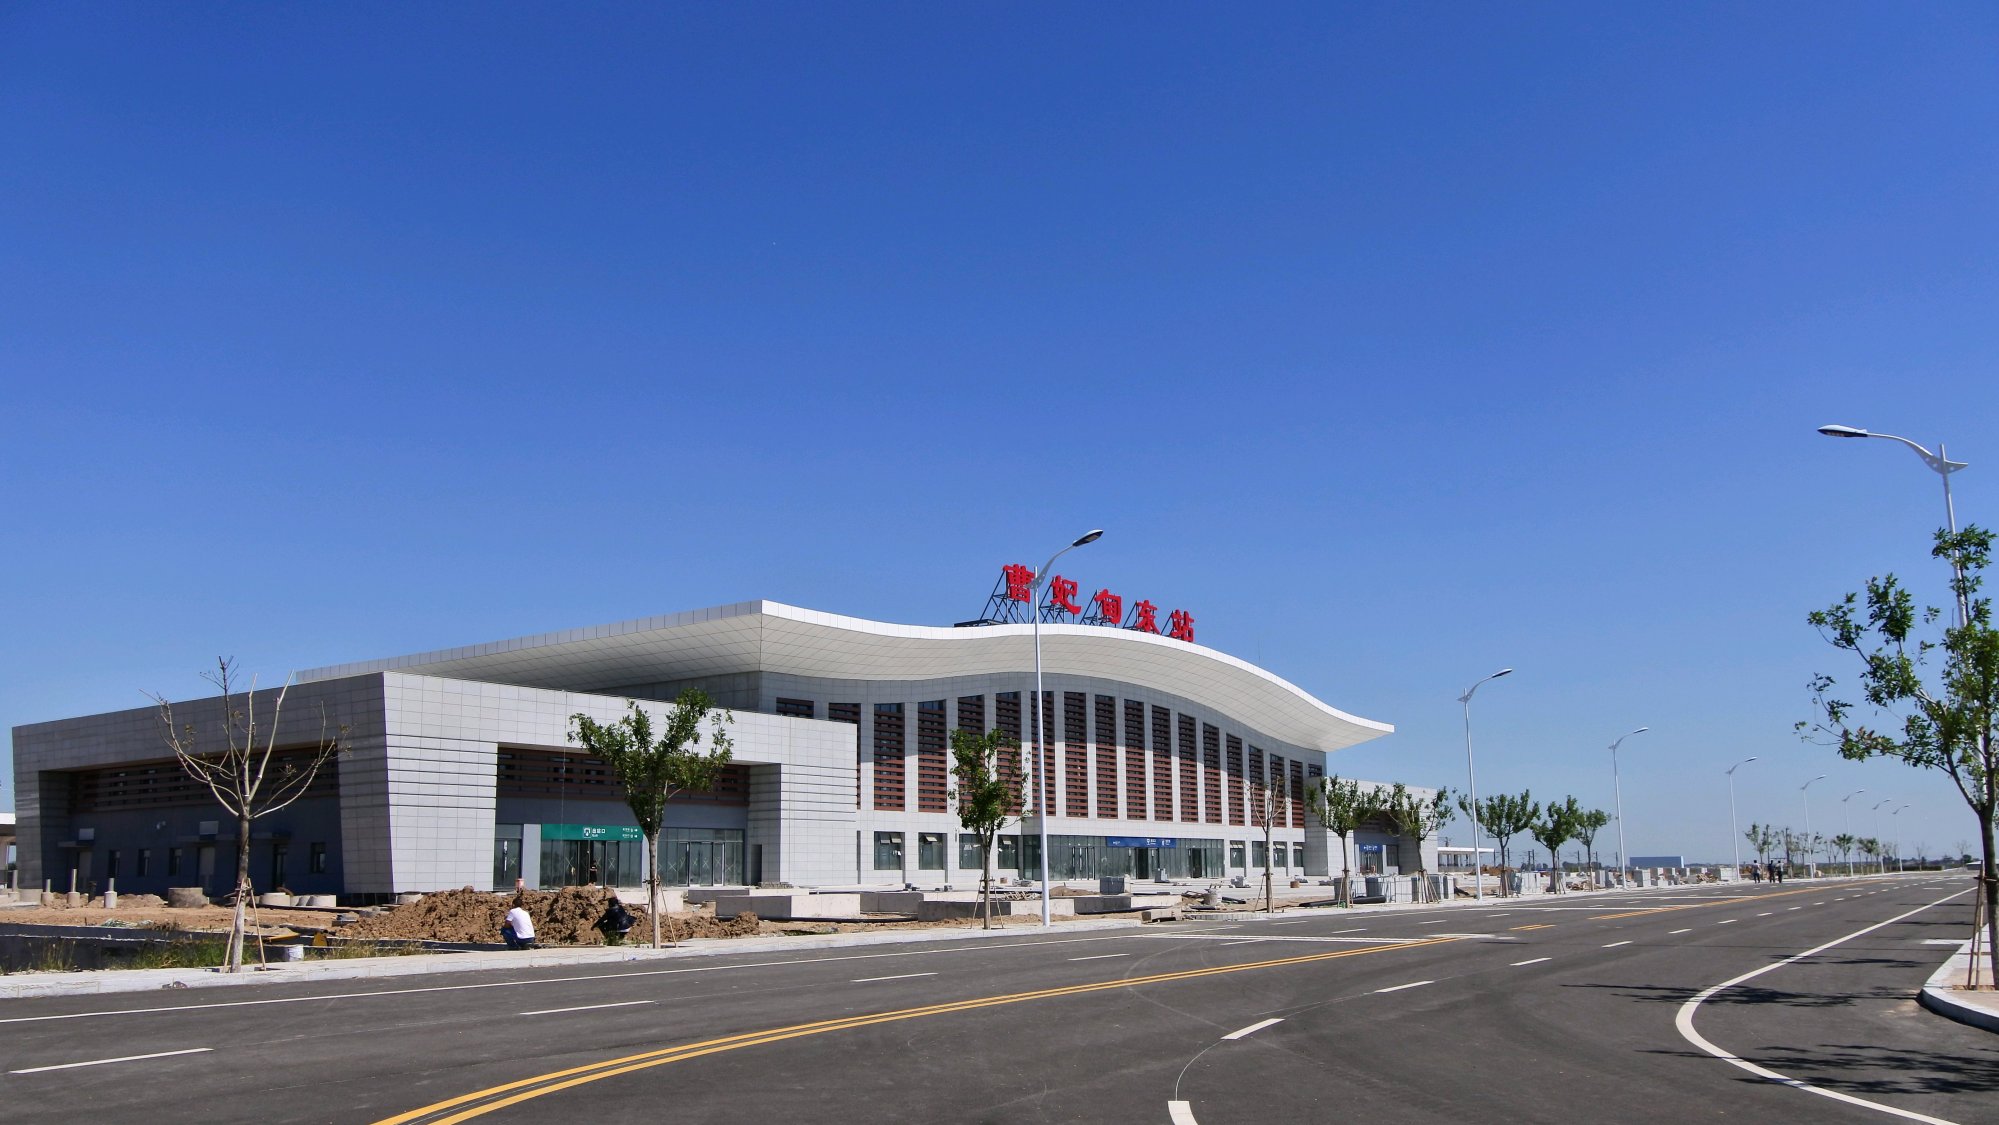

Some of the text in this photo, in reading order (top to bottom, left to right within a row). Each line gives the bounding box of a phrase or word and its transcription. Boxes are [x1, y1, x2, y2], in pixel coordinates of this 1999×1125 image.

[1003, 564, 1194, 642] 曹妃甸东站
